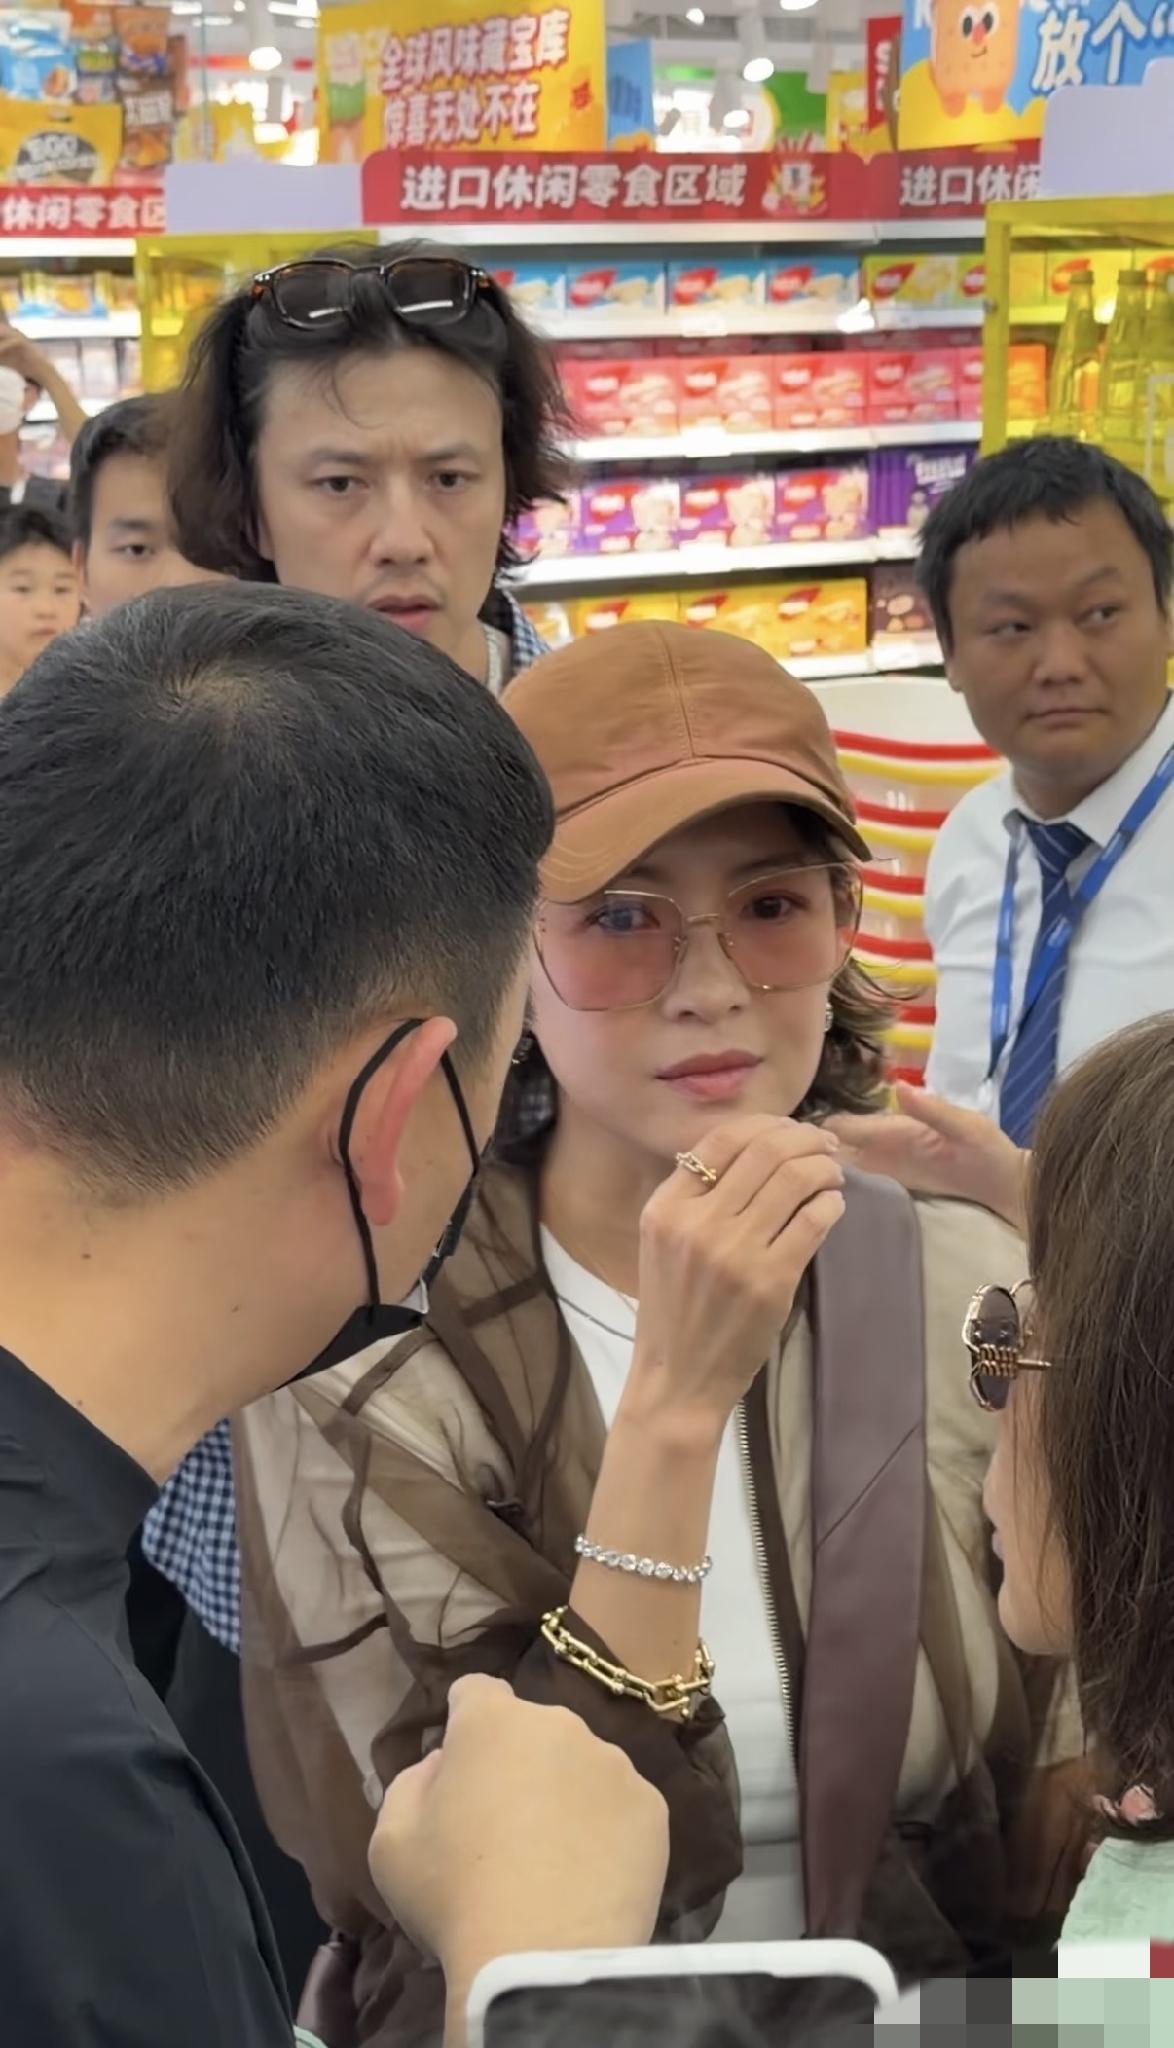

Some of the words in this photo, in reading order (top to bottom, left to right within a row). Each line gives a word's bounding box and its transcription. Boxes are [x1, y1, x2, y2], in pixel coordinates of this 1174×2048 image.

[381, 9, 570, 91] 全球风味藏宝库
[384, 79, 541, 149] 惊喜无处不在
[400, 163, 747, 210] 进口休闲零食区域
